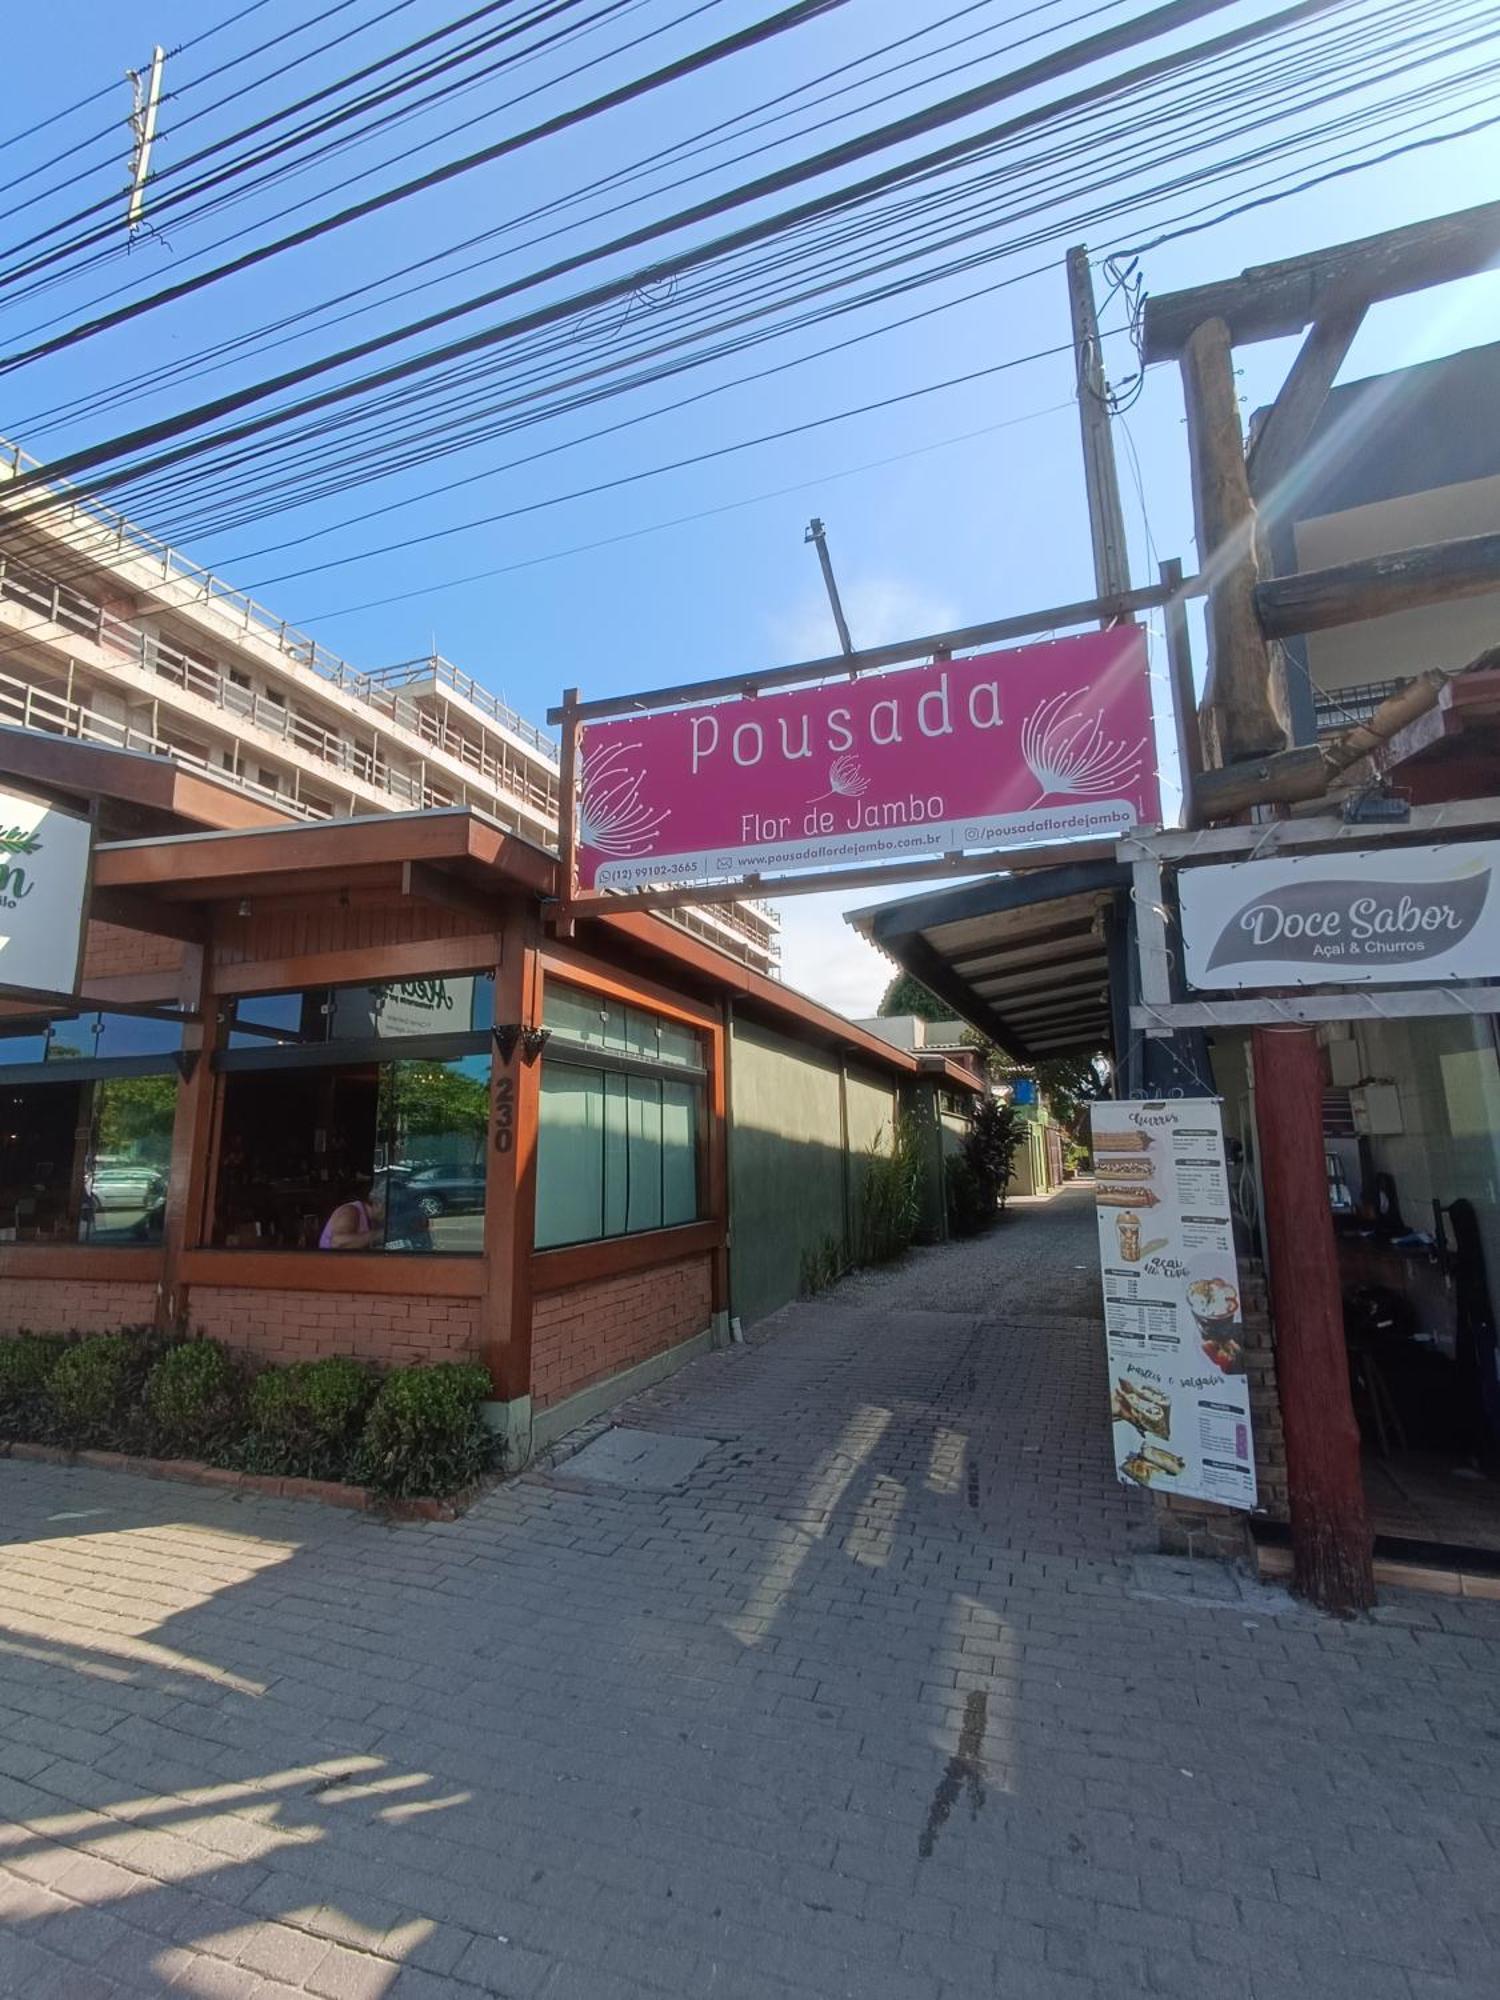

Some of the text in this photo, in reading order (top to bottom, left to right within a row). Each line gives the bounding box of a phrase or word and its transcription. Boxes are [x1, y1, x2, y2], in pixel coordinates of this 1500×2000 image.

[690, 673, 1003, 774] Pousada
[741, 794, 944, 842] Flor de Jambo
[611, 862, 698, 882] (12) 99102-3665
[738, 832, 942, 867] www.pousadaflordejambo.com.br
[1240, 896, 1462, 945] Doce Sabor
[1349, 942, 1360, 954] &
[1364, 941, 1425, 953] Churros
[495, 1078, 513, 1153] 230
